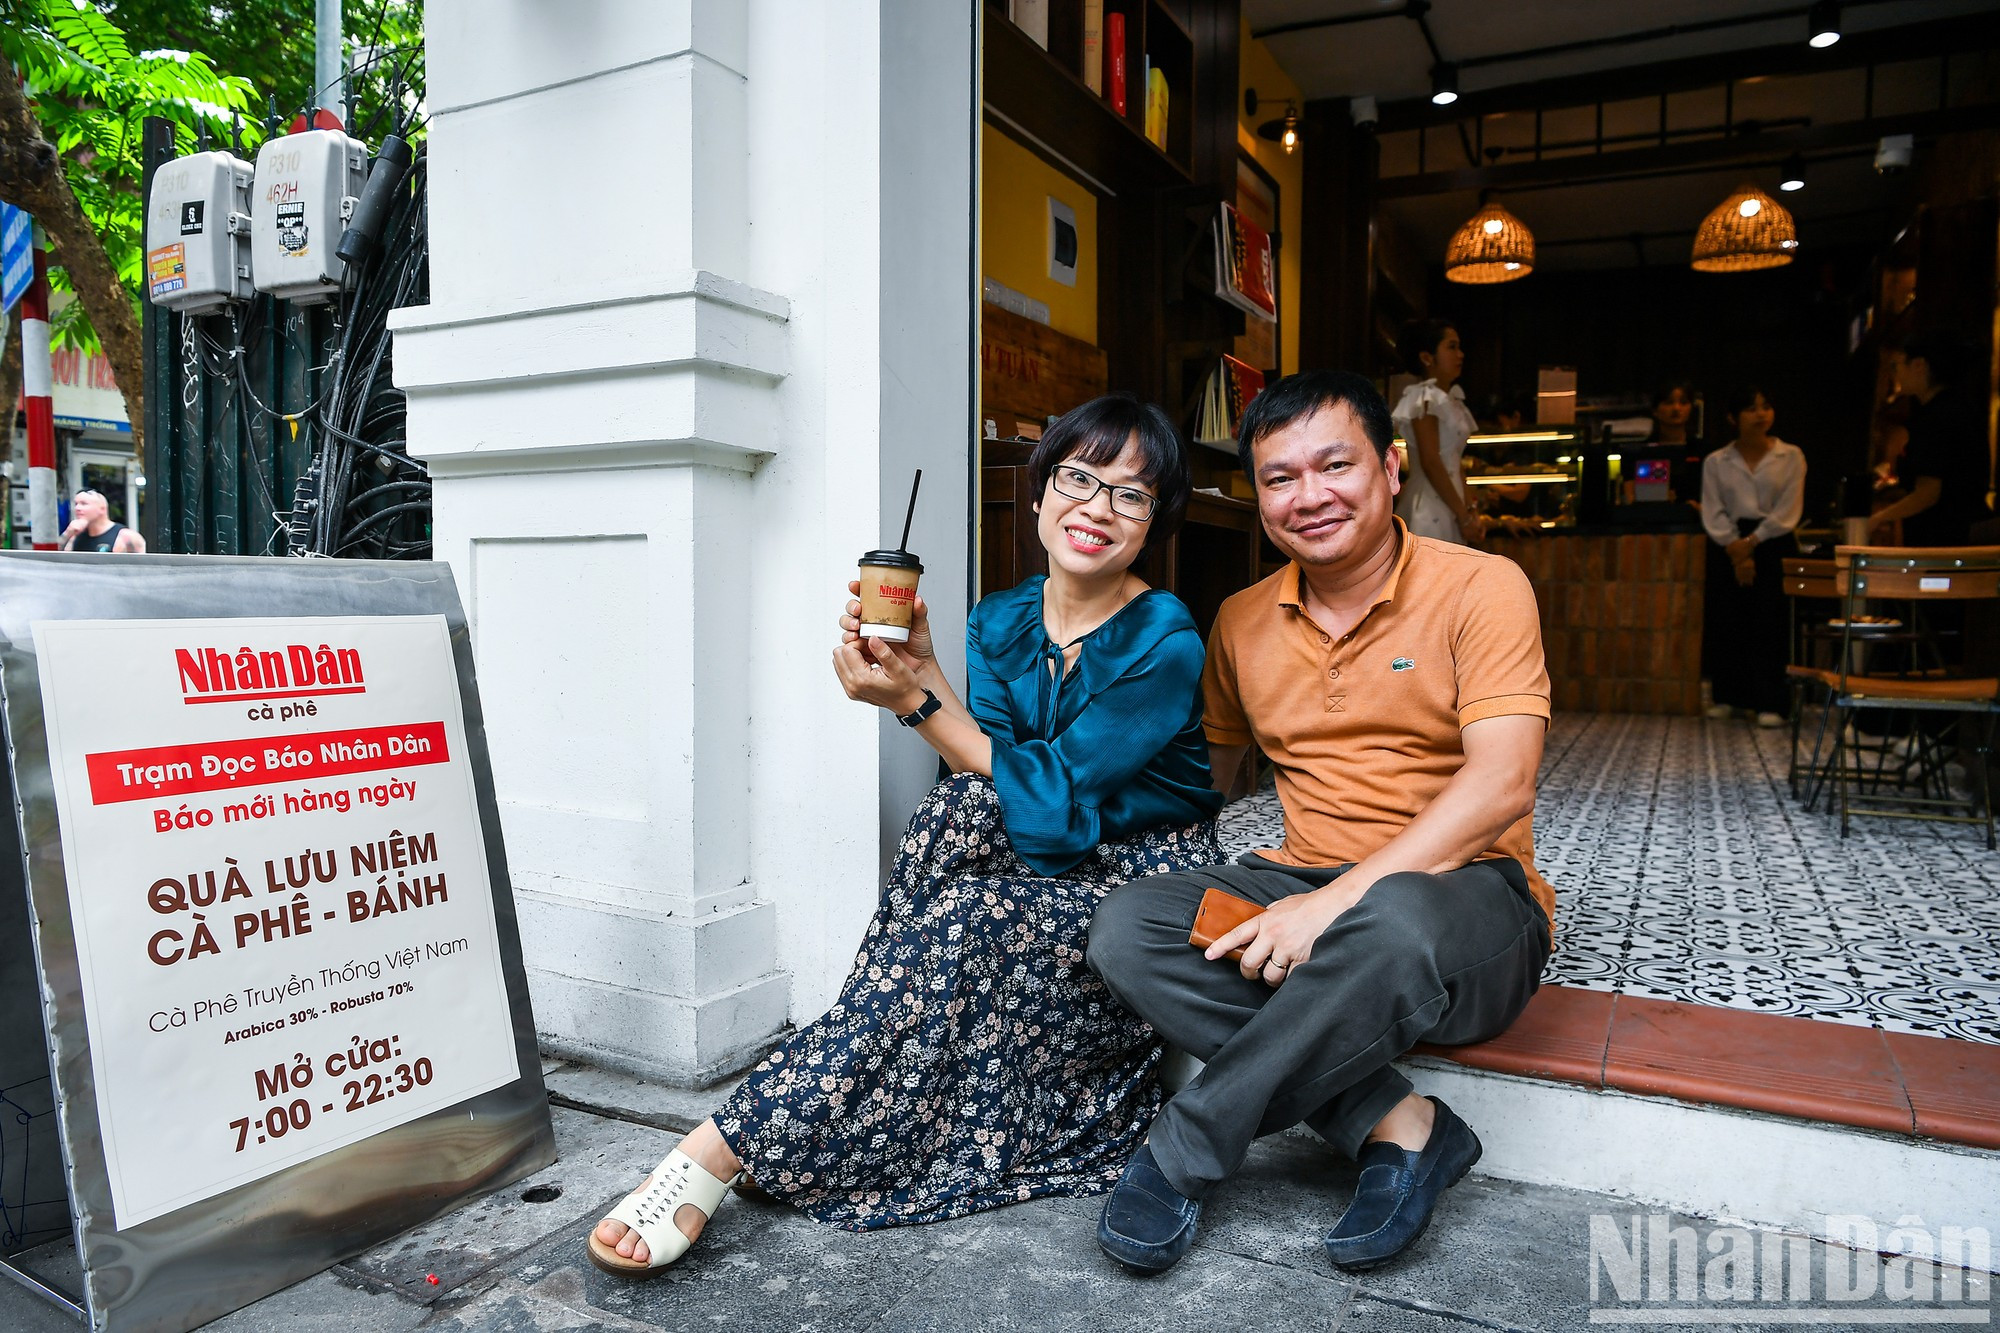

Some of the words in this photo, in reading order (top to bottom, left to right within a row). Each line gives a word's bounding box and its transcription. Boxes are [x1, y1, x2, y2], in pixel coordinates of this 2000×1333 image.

[268, 151, 301, 175] P310
[266, 180, 298, 205] 462H
[278, 203, 303, 215] ERNIE
[880, 585, 903, 596] Nhân
[176, 647, 288, 693] Nhân
[287, 644, 364, 686] Dân
[248, 703, 274, 720] cà
[280, 700, 317, 721] phê
[117, 763, 192, 788] Trạm
[201, 756, 256, 780] Đọc
[264, 745, 313, 769] Báo
[320, 739, 381, 763] Nhân
[388, 734, 430, 755] Dân
[154, 804, 213, 832] Báo
[223, 794, 275, 823] mới
[284, 789, 351, 814] hàng
[359, 778, 416, 807] ngày
[148, 857, 253, 914] QUÀ
[265, 849, 337, 893] LƯU
[350, 830, 438, 881] NIỆM
[148, 913, 221, 966] CÀ
[234, 893, 312, 948] PHÊ
[324, 911, 335, 920] -
[347, 873, 448, 923] BÁNH
[149, 1007, 186, 1032] Cà
[194, 994, 237, 1021] Phê
[243, 975, 314, 1007] Truyền
[319, 960, 380, 987] Thống
[385, 947, 420, 969] Việt
[426, 939, 468, 959] Nam
[224, 1019, 285, 1044] Arabica
[290, 1008, 318, 1025] 30%
[330, 991, 384, 1013] Robusta
[388, 982, 413, 997] 70%
[255, 1053, 313, 1101] Mở
[326, 1035, 401, 1077] cửa:
[230, 1100, 311, 1152] 7:00
[322, 1104, 333, 1112] -
[343, 1057, 433, 1112] 22:30
